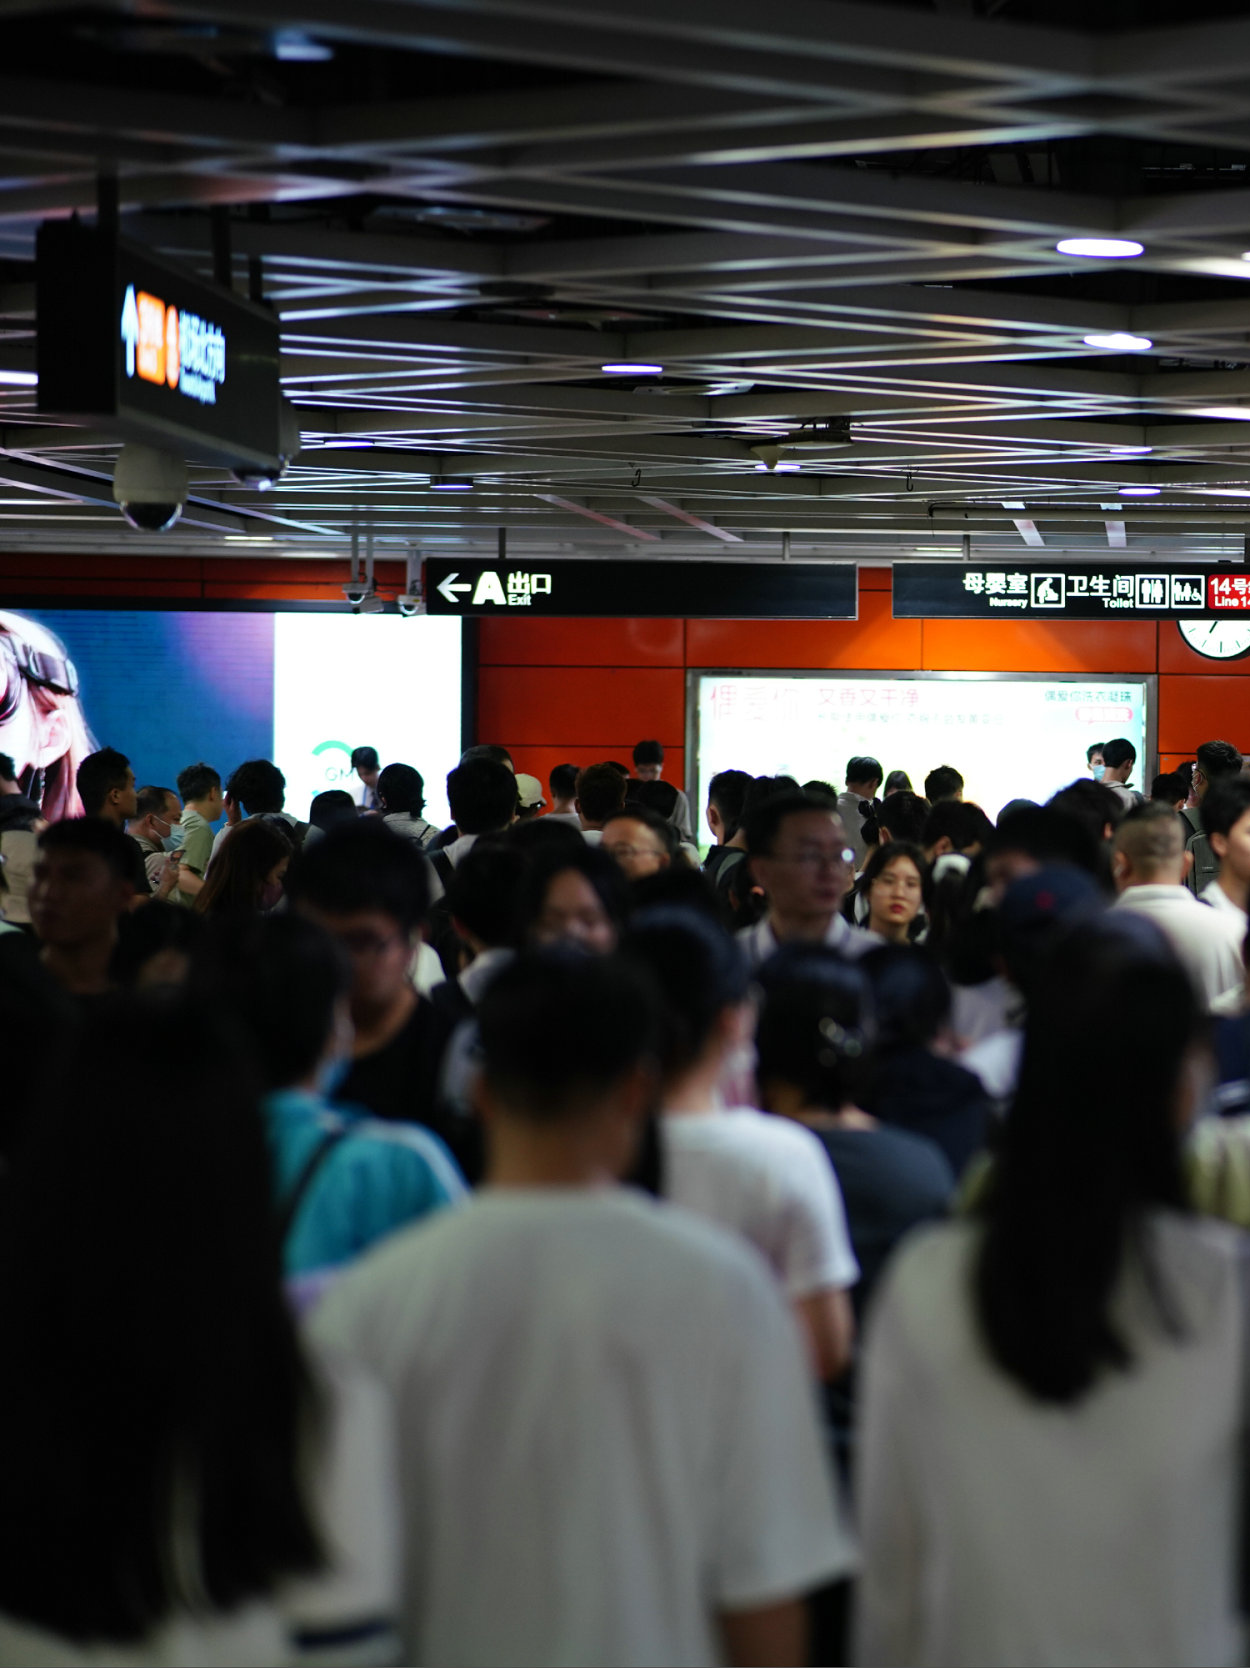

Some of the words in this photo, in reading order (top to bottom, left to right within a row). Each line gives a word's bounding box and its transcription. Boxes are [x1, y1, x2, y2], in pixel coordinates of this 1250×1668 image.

[472, 571, 507, 605] A
[507, 571, 552, 594] 出口
[962, 572, 1029, 594] 母婴室
[1066, 574, 1135, 597] 卫生间
[507, 593, 532, 606] Exit
[989, 597, 1028, 609] Nursery
[1102, 597, 1134, 608] Toilet
[1214, 596, 1240, 607] Line
